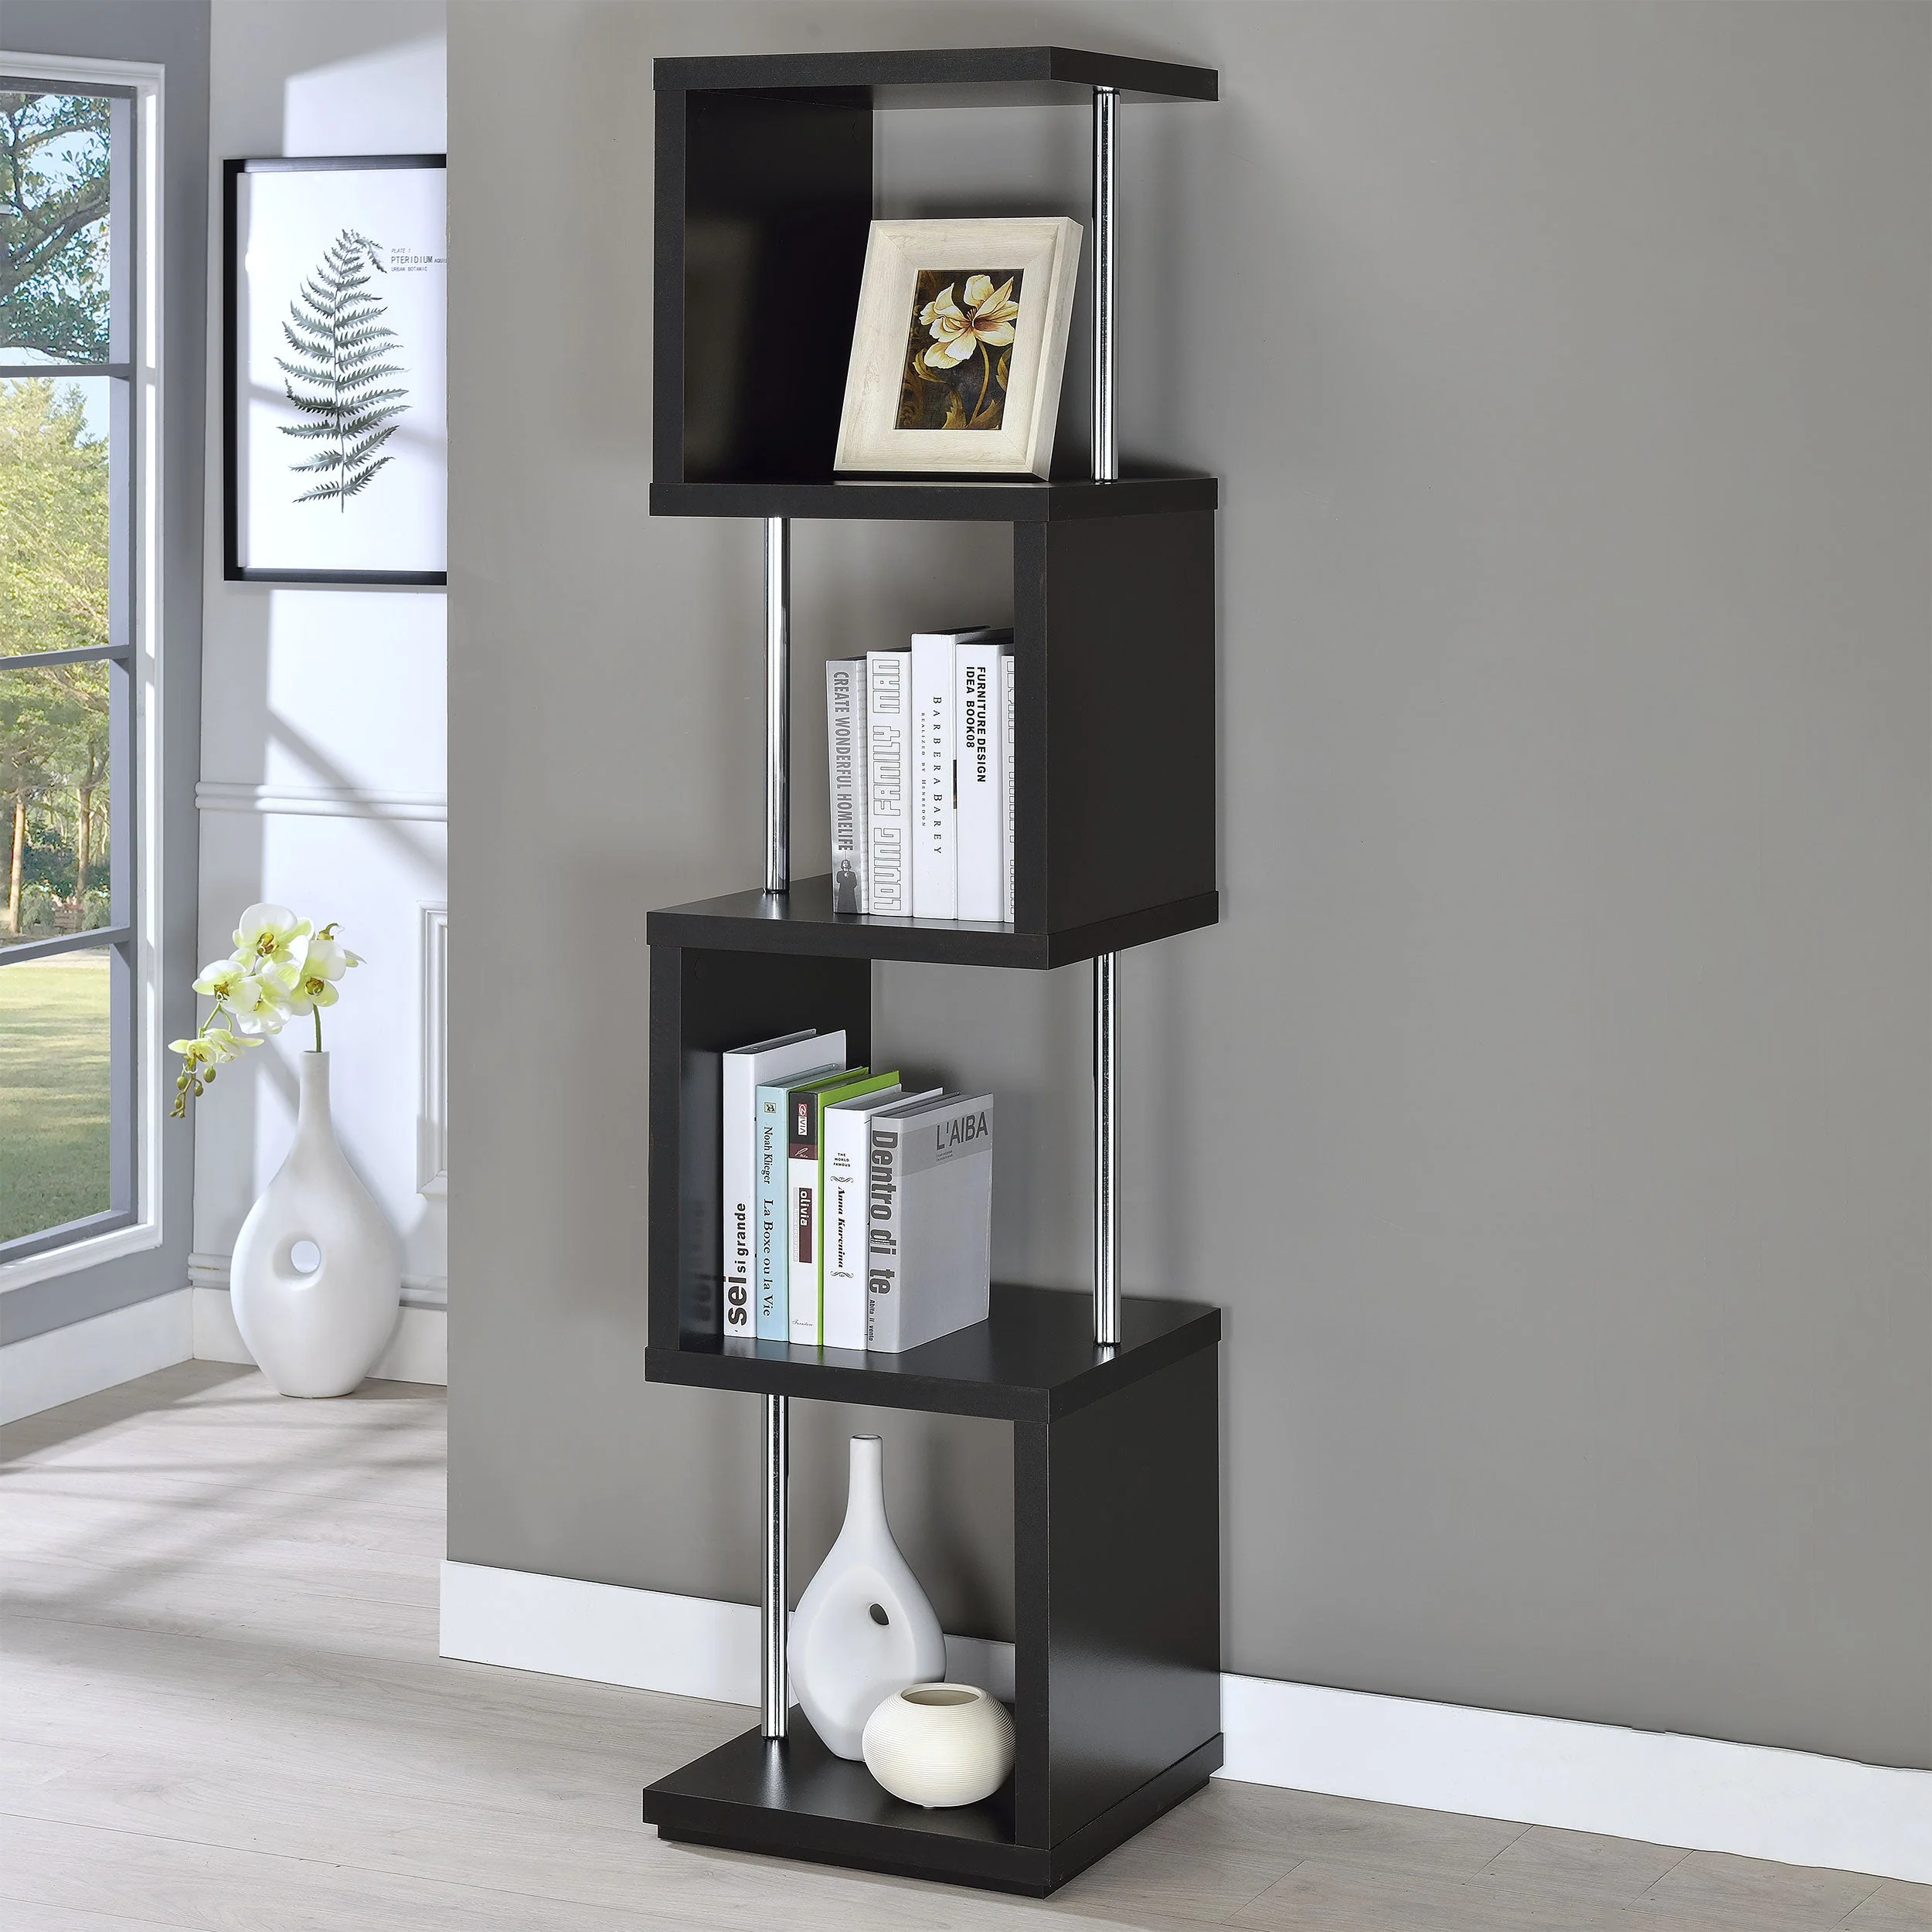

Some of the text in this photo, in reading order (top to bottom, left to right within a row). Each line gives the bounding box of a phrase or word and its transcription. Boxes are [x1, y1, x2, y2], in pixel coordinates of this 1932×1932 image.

[966, 666, 975, 748] IDEA BOOK08
[977, 666, 986, 783] FURNITURE DESIGN
[833, 671, 853, 851] CREATE WONDERFUL HOMELIFE
[933, 696, 942, 854] BARBERA BAREY
[872, 659, 901, 911] LOVING FAMILY MAN
[764, 1126, 773, 1151] Noah
[936, 1111, 988, 1151] L'AIBA
[870, 1130, 898, 1221] Dentro
[764, 1199, 774, 1216] La
[800, 1190, 811, 1226] olivia
[870, 1229, 896, 1256] di
[723, 1202, 749, 1326] sei si grande
[764, 1257, 770, 1274] ou
[869, 1268, 896, 1294] te
[764, 1278, 774, 1291] la
[763, 1294, 774, 1317] Vie
